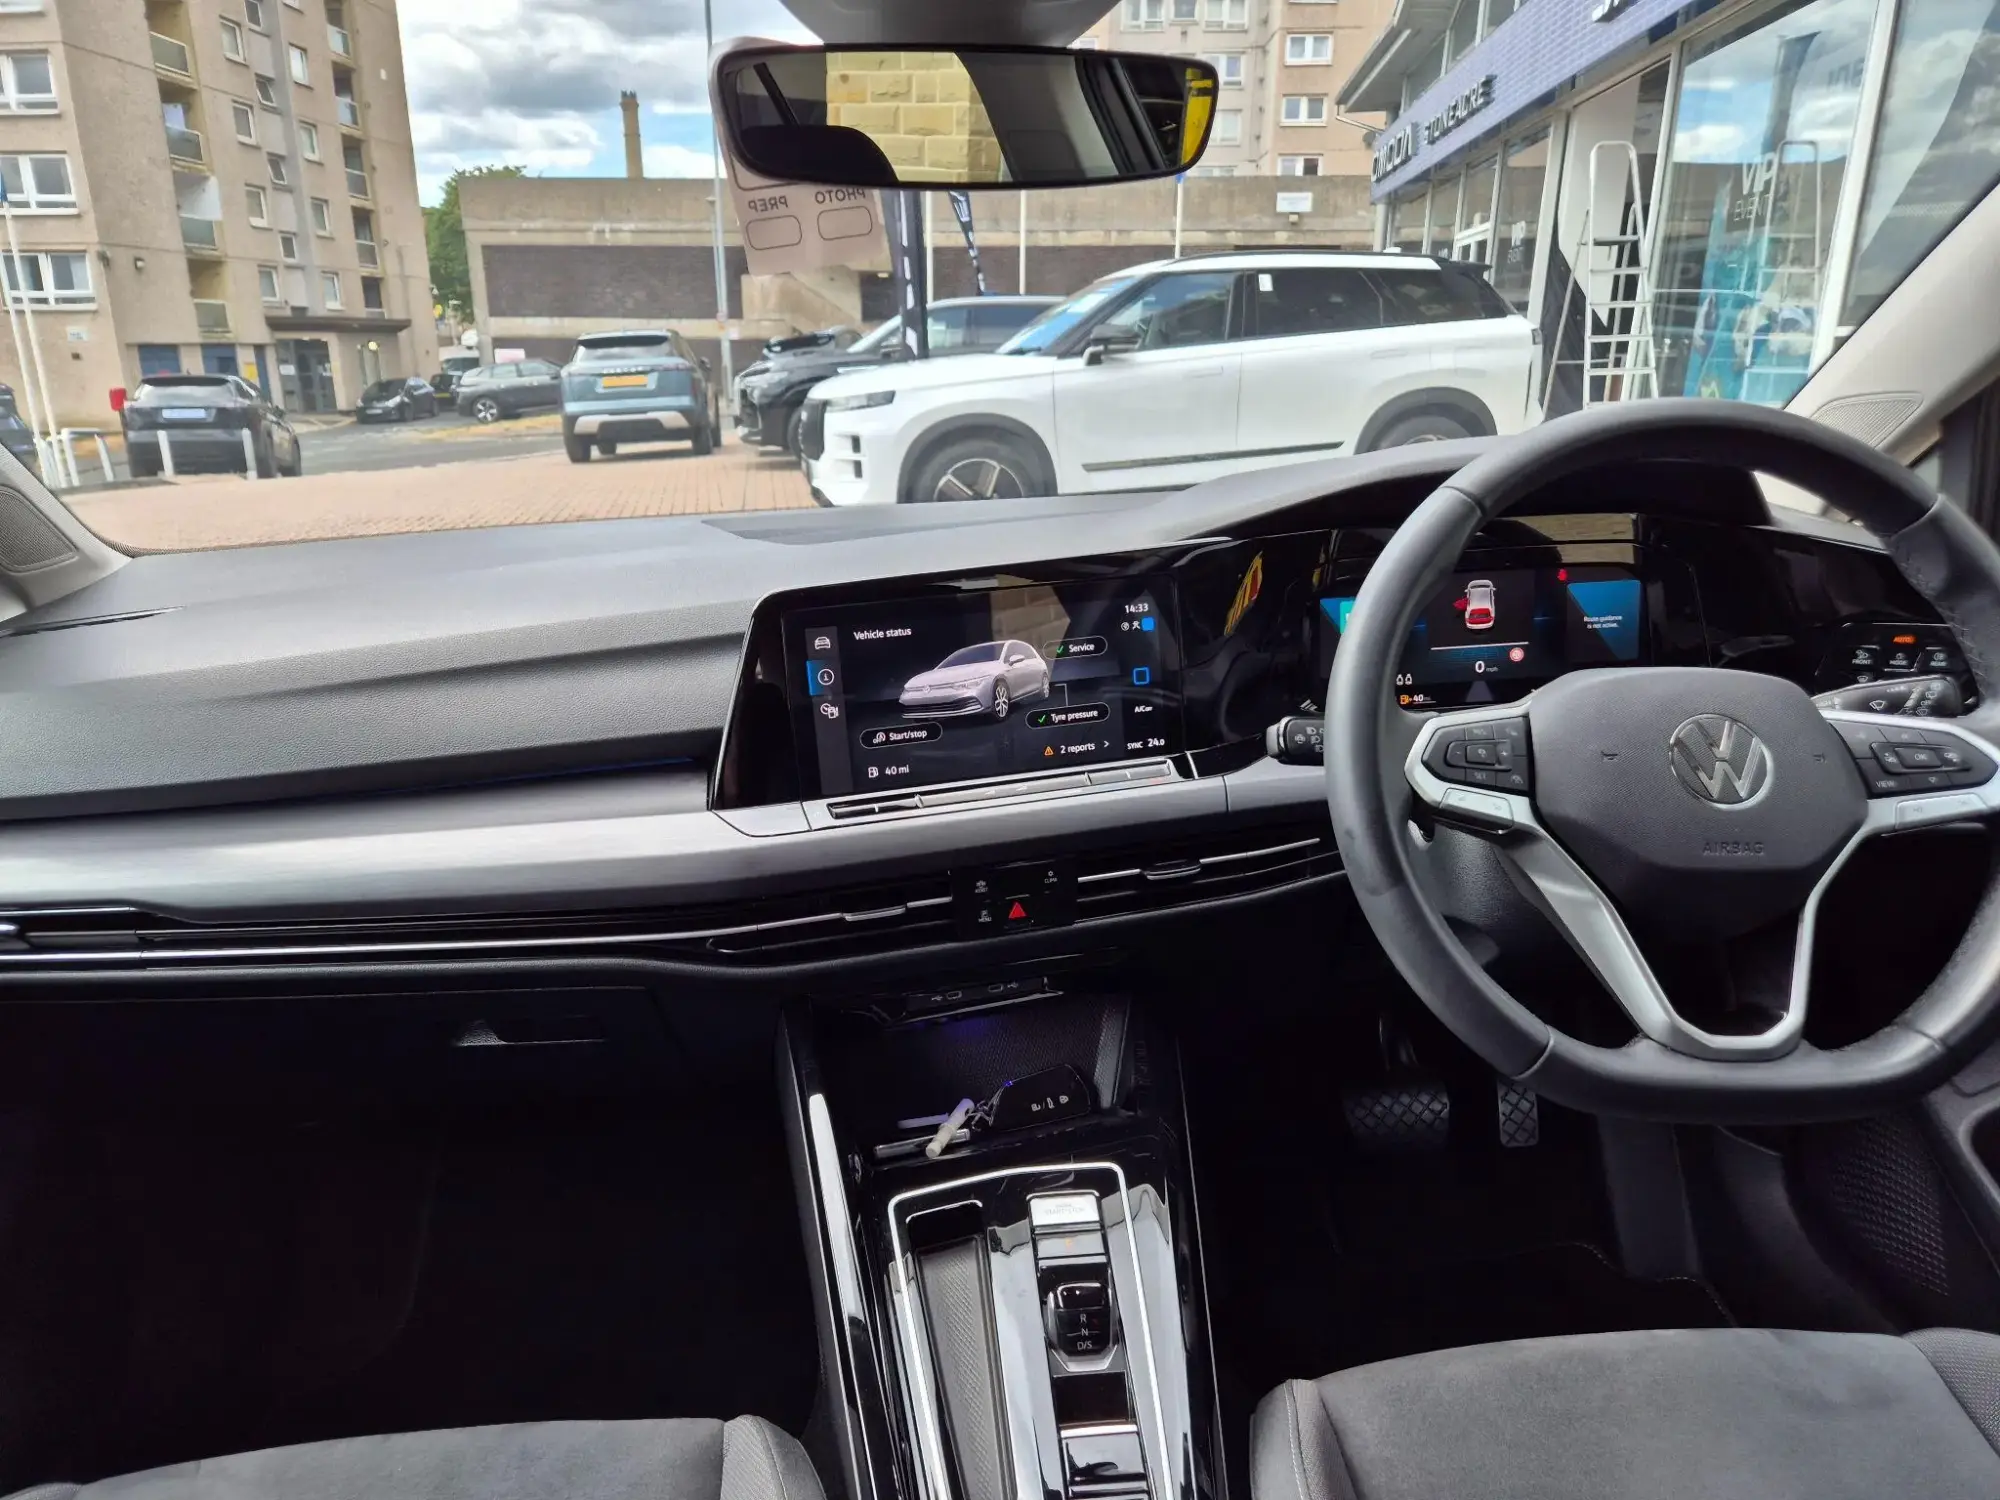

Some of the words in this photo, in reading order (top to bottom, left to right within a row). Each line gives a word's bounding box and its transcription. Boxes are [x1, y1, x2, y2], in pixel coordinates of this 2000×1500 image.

[1742, 151, 1776, 195] VIP
[1125, 603, 1149, 613] 14:33
[853, 629, 885, 641] Vehicle
[885, 628, 912, 638] status
[1068, 643, 1095, 653] Service
[1475, 660, 1485, 673] 0
[1413, 694, 1424, 702] 40
[1051, 712, 1067, 724] Tyre
[1067, 710, 1099, 721] pressure
[889, 730, 928, 741] Start/stop
[1060, 745, 1066, 754] 2
[1067, 743, 1096, 754] reports
[1127, 741, 1143, 750] SYNC
[1147, 738, 1165, 748] 24.0
[885, 765, 898, 776] 40
[1875, 780, 1896, 789] VIEW
[1702, 840, 1766, 857] AIRBAG
[1080, 1313, 1087, 1323] R
[1081, 1327, 1089, 1336] N
[1077, 1340, 1093, 1351] D/S
